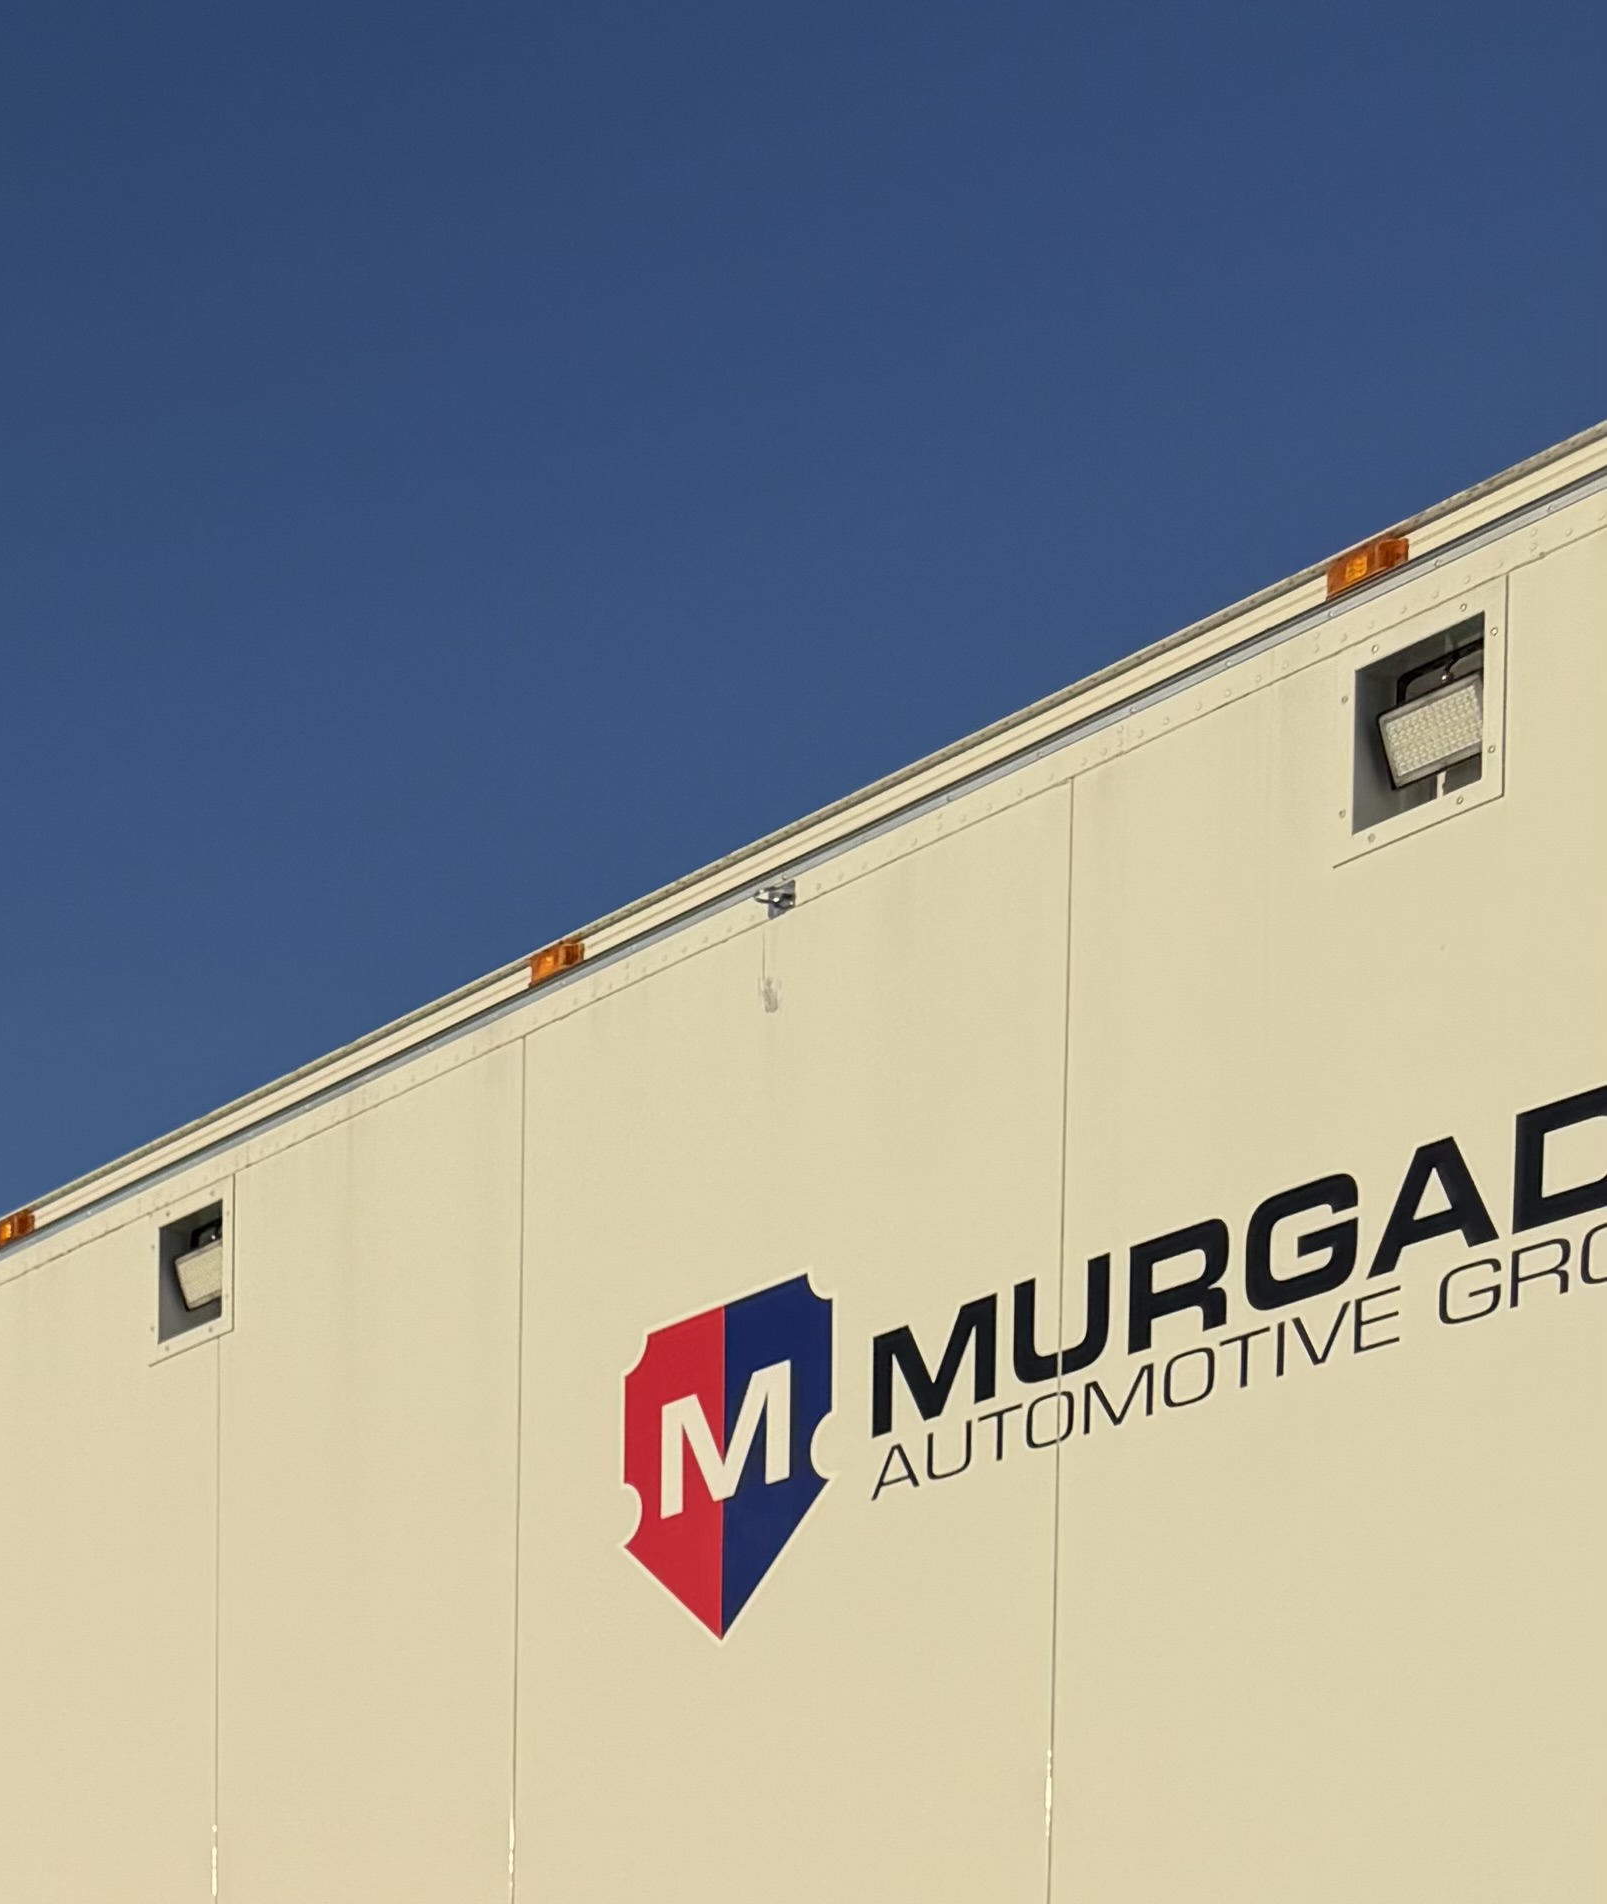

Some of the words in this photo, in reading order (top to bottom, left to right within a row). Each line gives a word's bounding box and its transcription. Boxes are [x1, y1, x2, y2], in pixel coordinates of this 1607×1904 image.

[871, 1084, 1607, 1438] MURGAD
[659, 1359, 792, 1521] M
[871, 1285, 1402, 1502] AUTOMOTIVE
